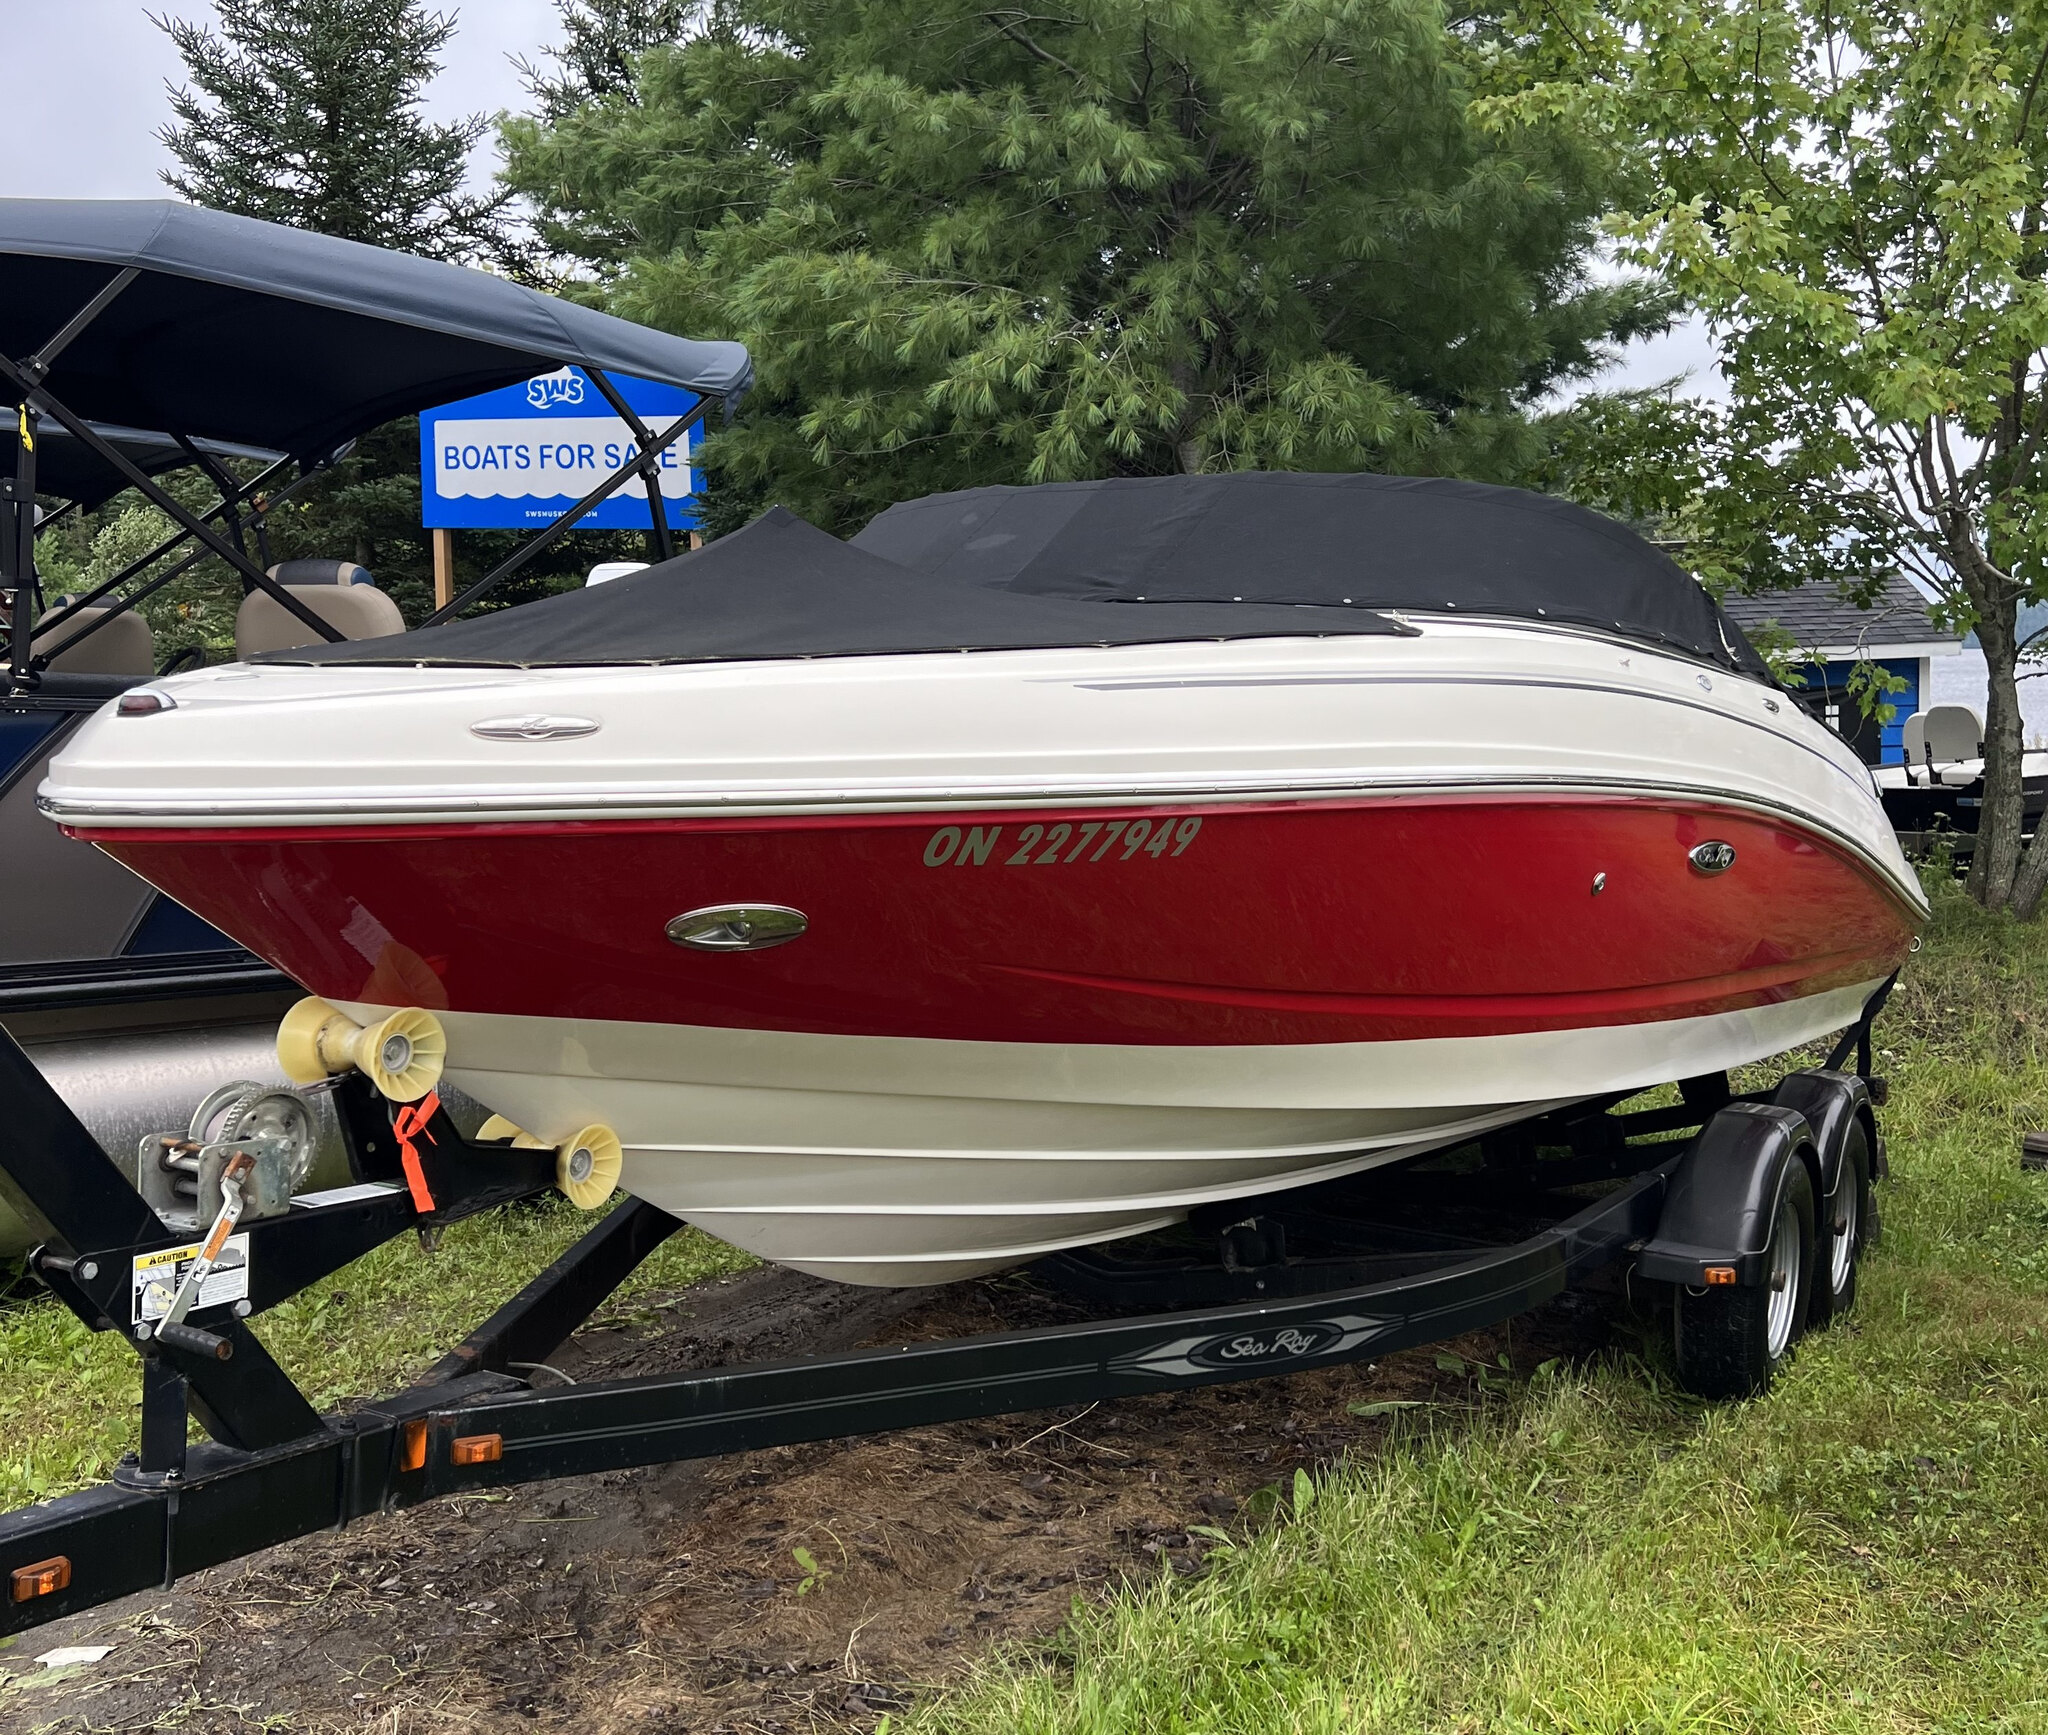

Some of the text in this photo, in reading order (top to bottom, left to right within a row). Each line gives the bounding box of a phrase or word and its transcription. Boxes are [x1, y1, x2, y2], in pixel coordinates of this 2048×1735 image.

[528, 377, 584, 404] SWS
[444, 443, 678, 470] BOATS FOR SAE
[923, 816, 1203, 867] ON 2277949
[157, 1250, 188, 1264] CAUTION
[1220, 1329, 1318, 1358] Sea Ray
